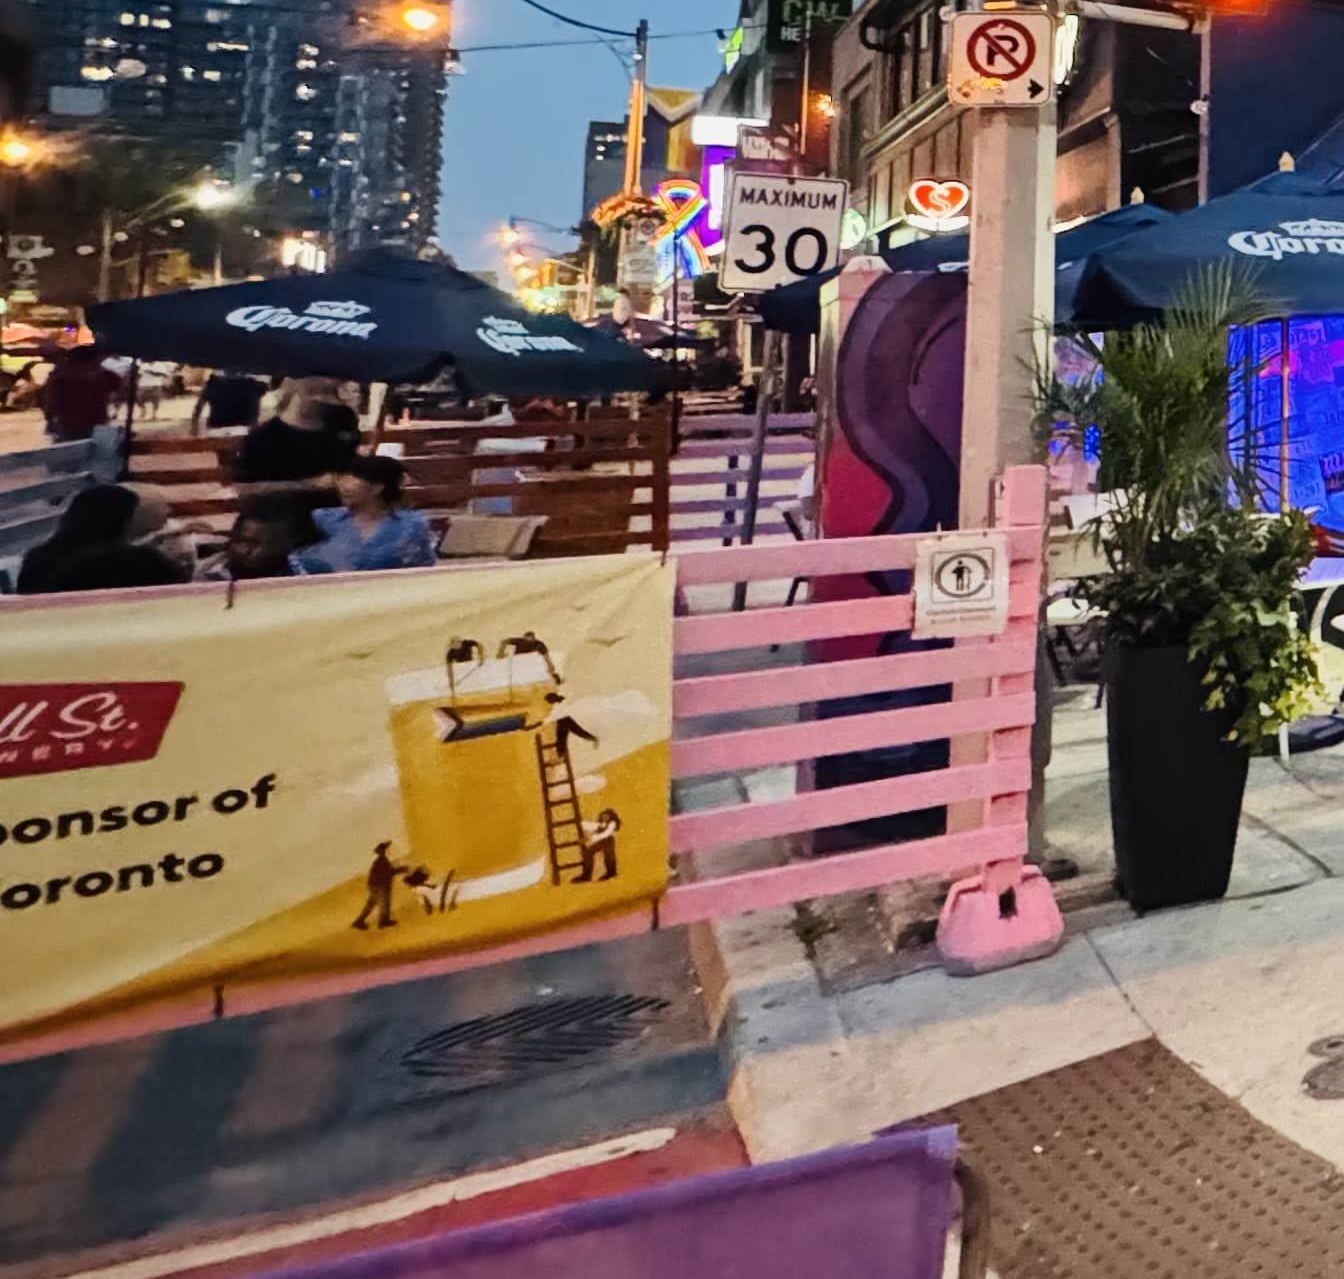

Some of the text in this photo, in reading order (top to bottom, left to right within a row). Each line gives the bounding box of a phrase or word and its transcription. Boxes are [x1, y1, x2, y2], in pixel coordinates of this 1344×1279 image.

[739, 186, 838, 211] MAXIMUM
[734, 224, 828, 277] 30
[212, 772, 277, 815] of
[0, 852, 225, 910] oronto
